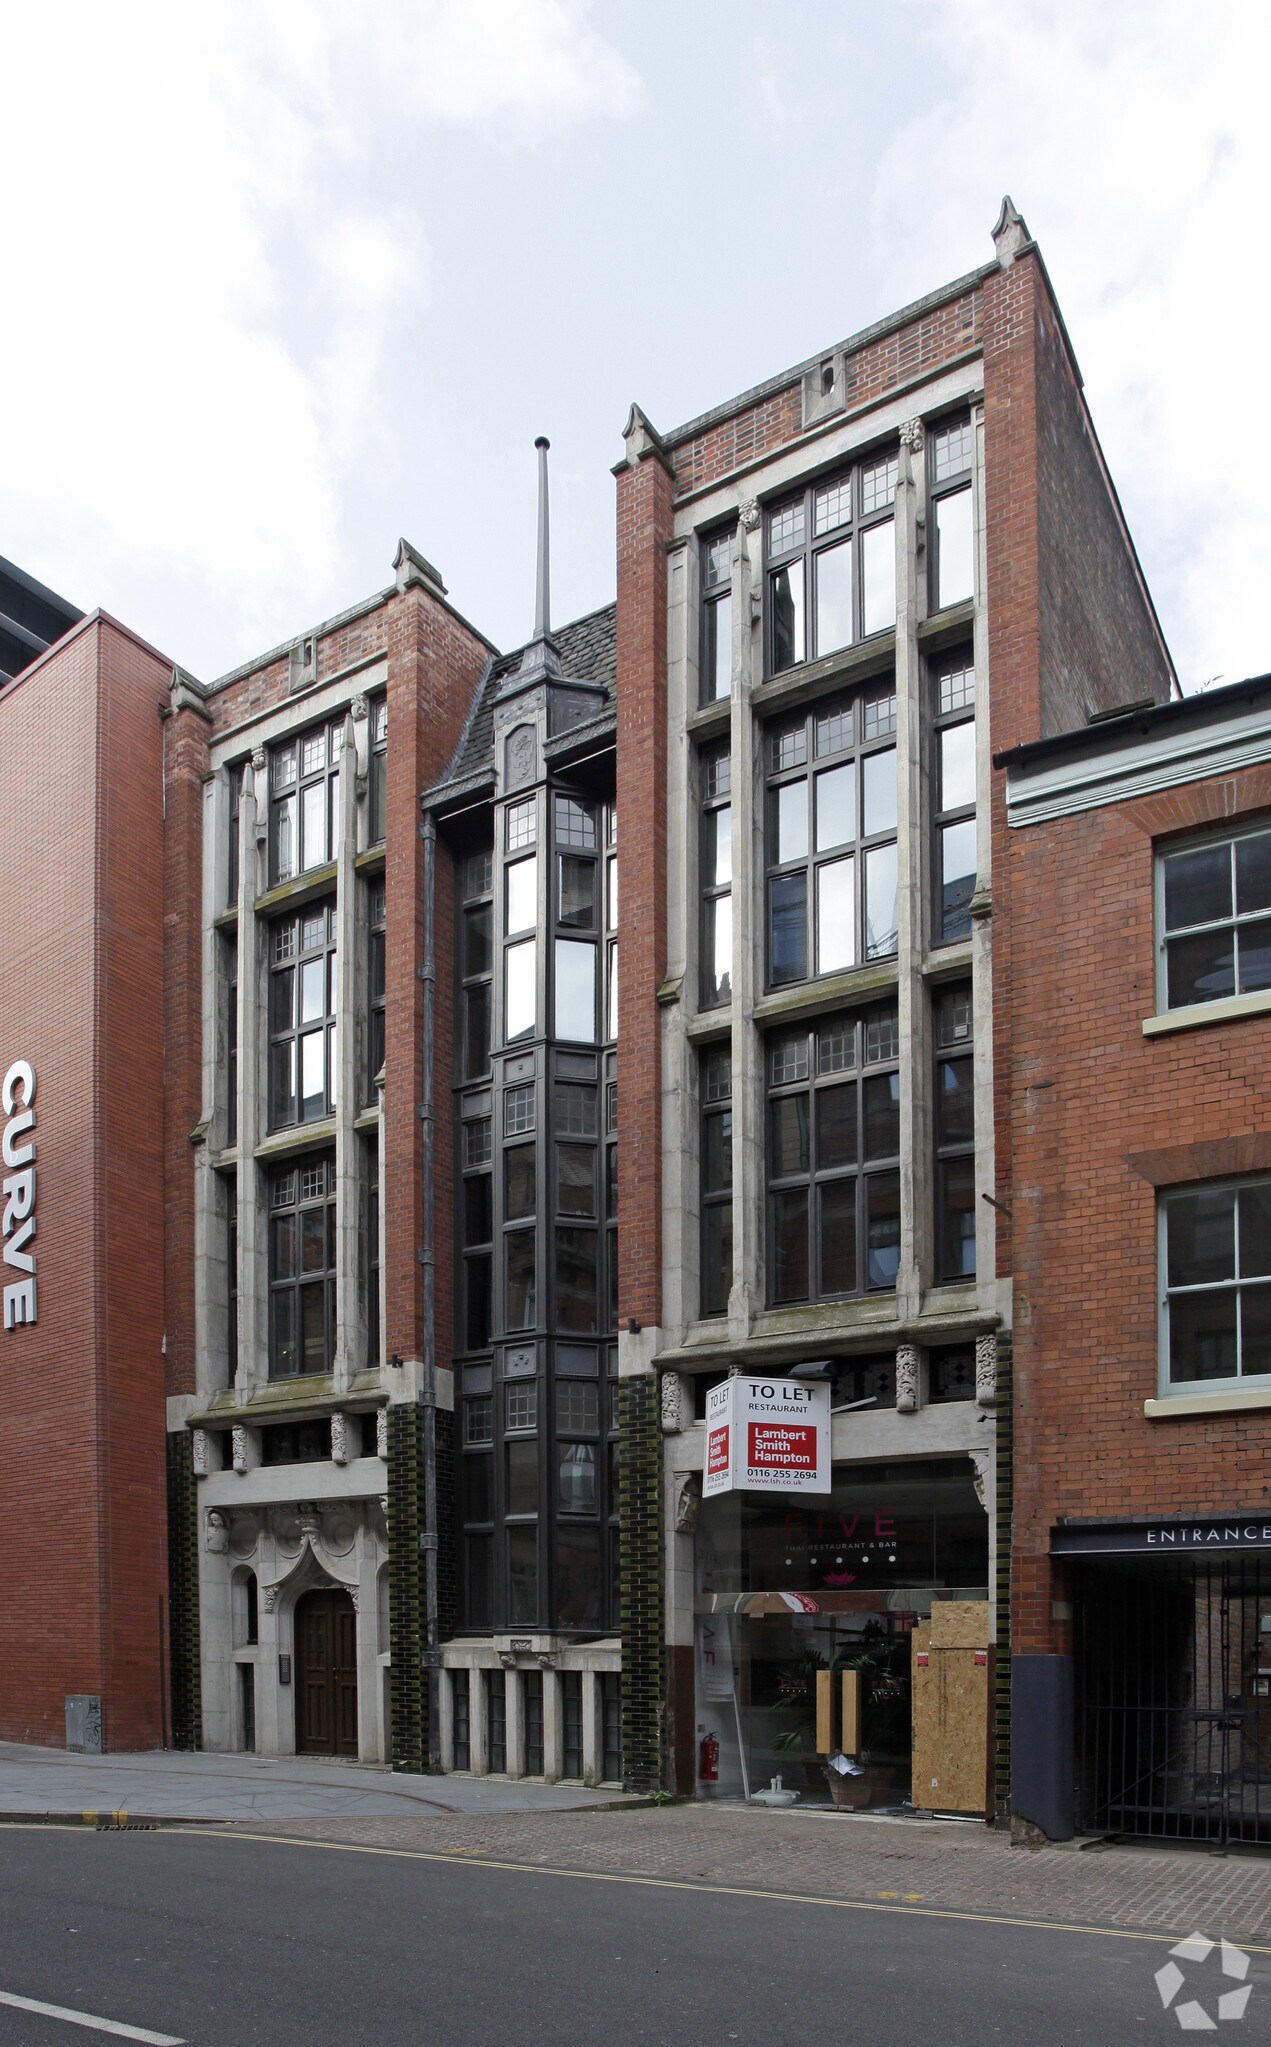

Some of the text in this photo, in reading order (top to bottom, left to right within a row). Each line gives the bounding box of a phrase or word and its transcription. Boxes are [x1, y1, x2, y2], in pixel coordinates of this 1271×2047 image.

[2, 1060, 37, 1331] CURVE
[710, 1387, 730, 1409] TO LET
[749, 1385, 815, 1401] TO LET
[748, 1403, 808, 1413] RESTAURANT
[755, 1428, 807, 1441] Lambert
[755, 1440, 791, 1451] Smith
[755, 1451, 810, 1464] Hampton
[747, 1469, 817, 1480] 0116 255 2694
[747, 1478, 803, 1486] www.lsh.co.uk
[784, 1508, 897, 1540] FIVE
[1147, 1525, 1271, 1543] ENTRANCE
[808, 1542, 866, 1550] RESTAURANT
